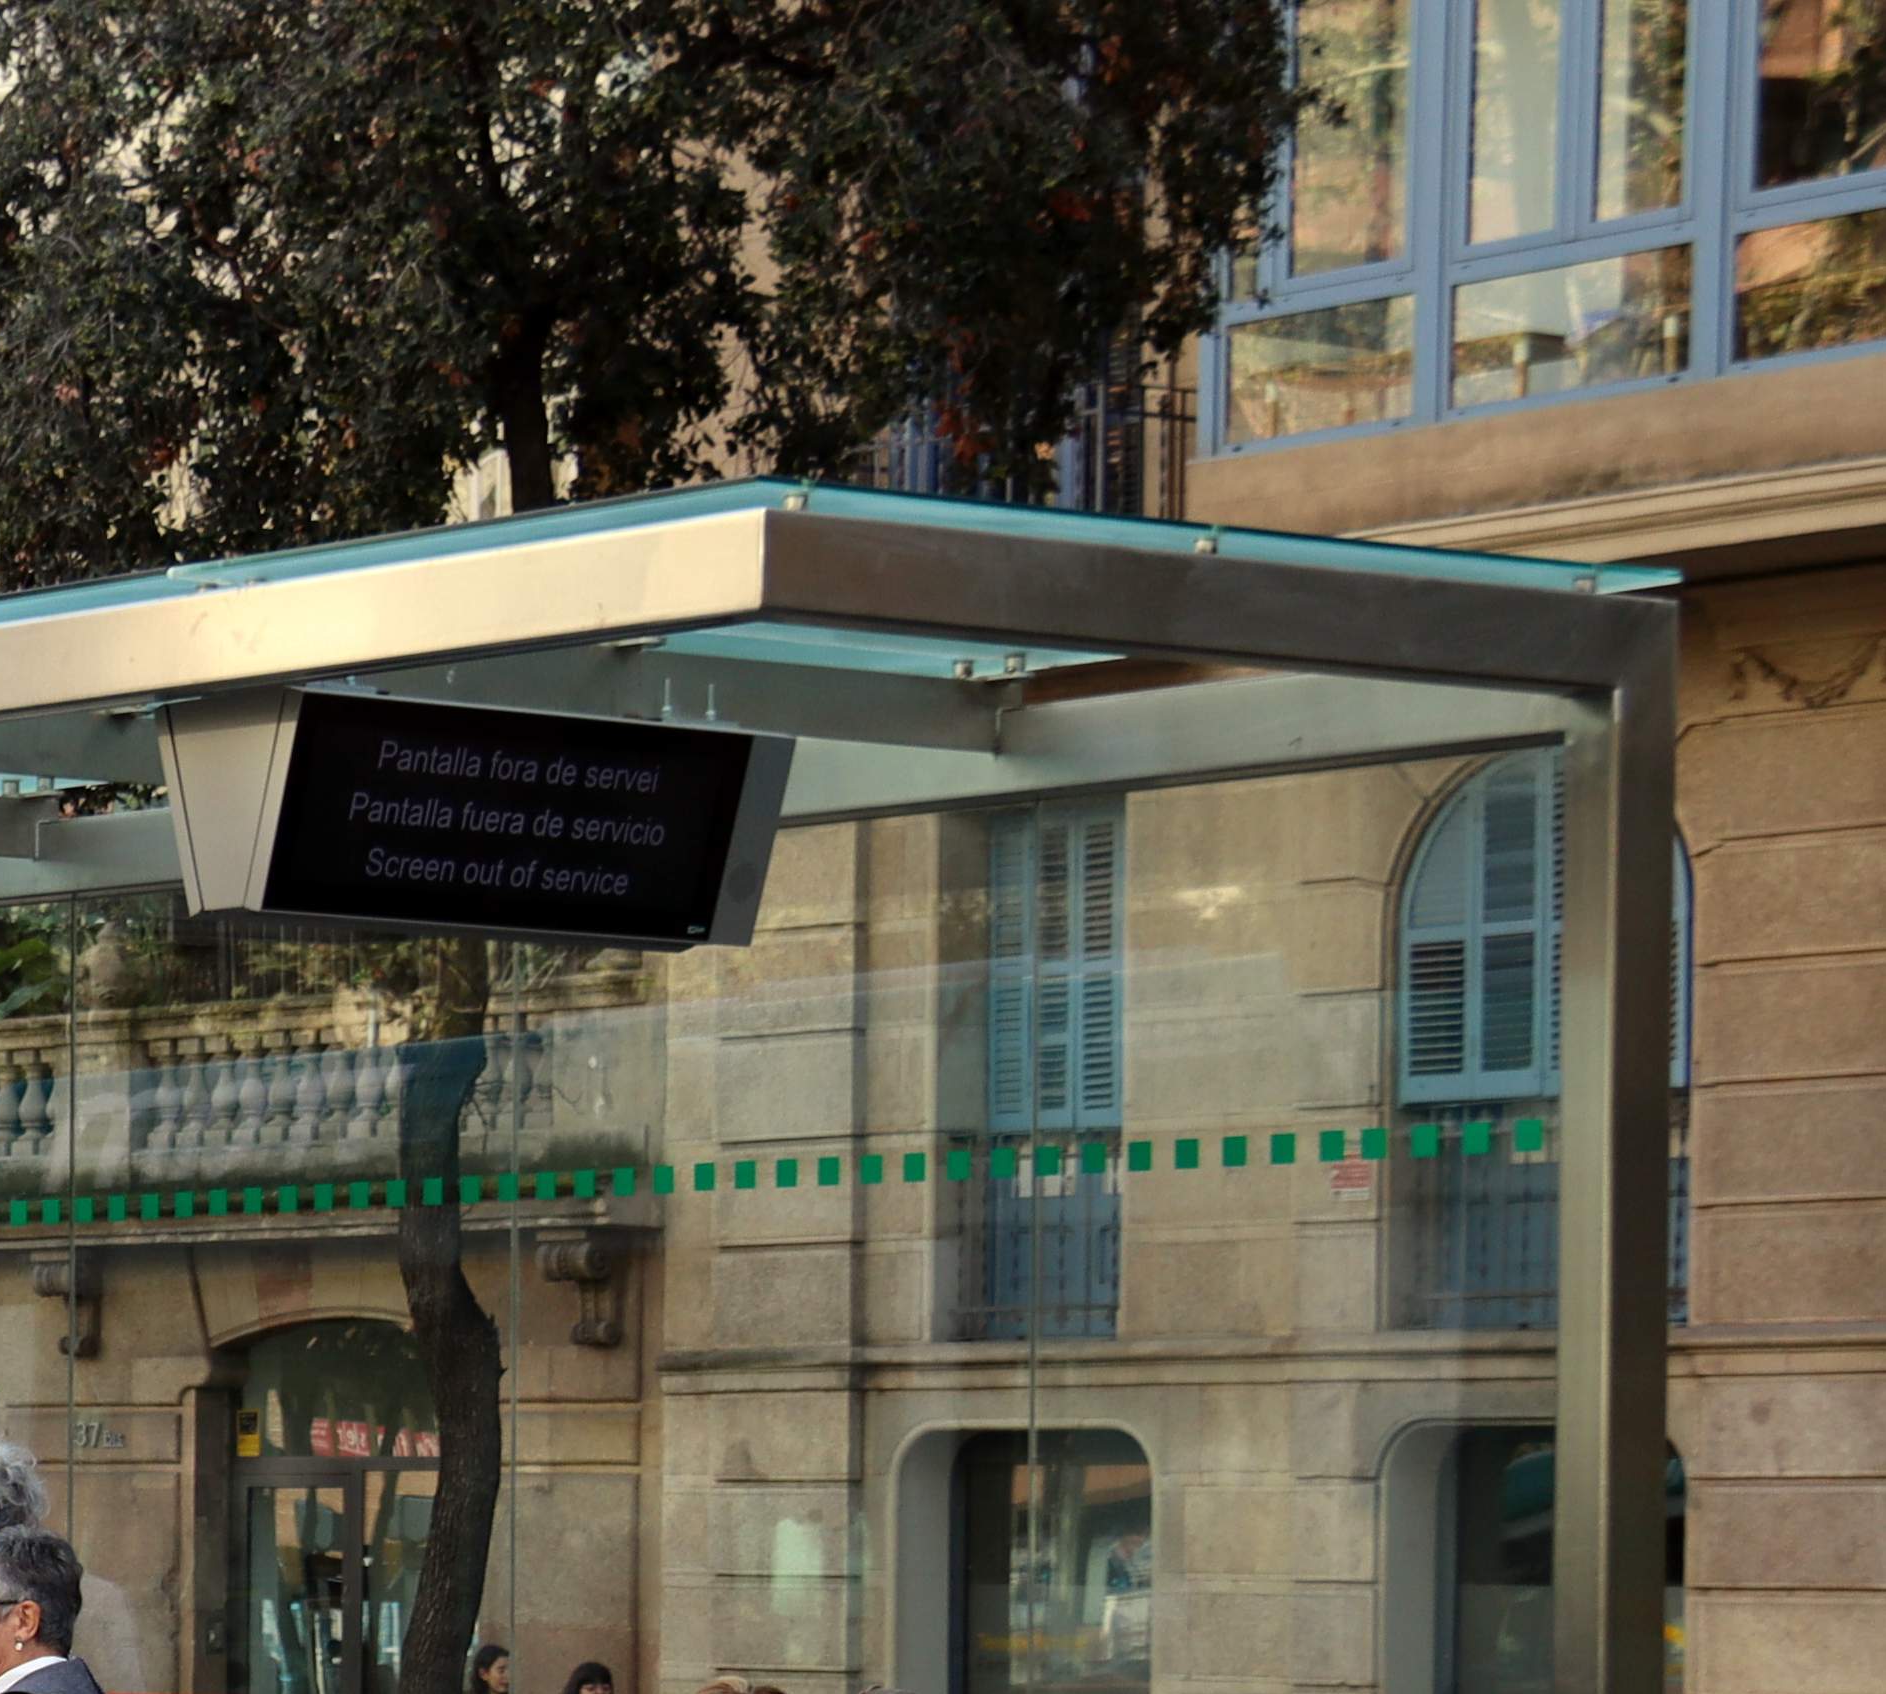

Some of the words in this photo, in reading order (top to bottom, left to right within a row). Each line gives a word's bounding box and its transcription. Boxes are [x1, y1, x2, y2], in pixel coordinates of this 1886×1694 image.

[377, 740, 482, 778] Pantalla
[489, 750, 539, 783] fora
[546, 756, 578, 787] de
[584, 765, 660, 794] servei
[348, 792, 453, 829] Pantalla
[461, 801, 525, 835] fuera
[533, 809, 564, 839] de
[571, 816, 665, 847] servicio
[365, 848, 455, 883] Screen
[463, 858, 503, 887] out
[510, 859, 538, 889] of
[541, 866, 629, 896] service
